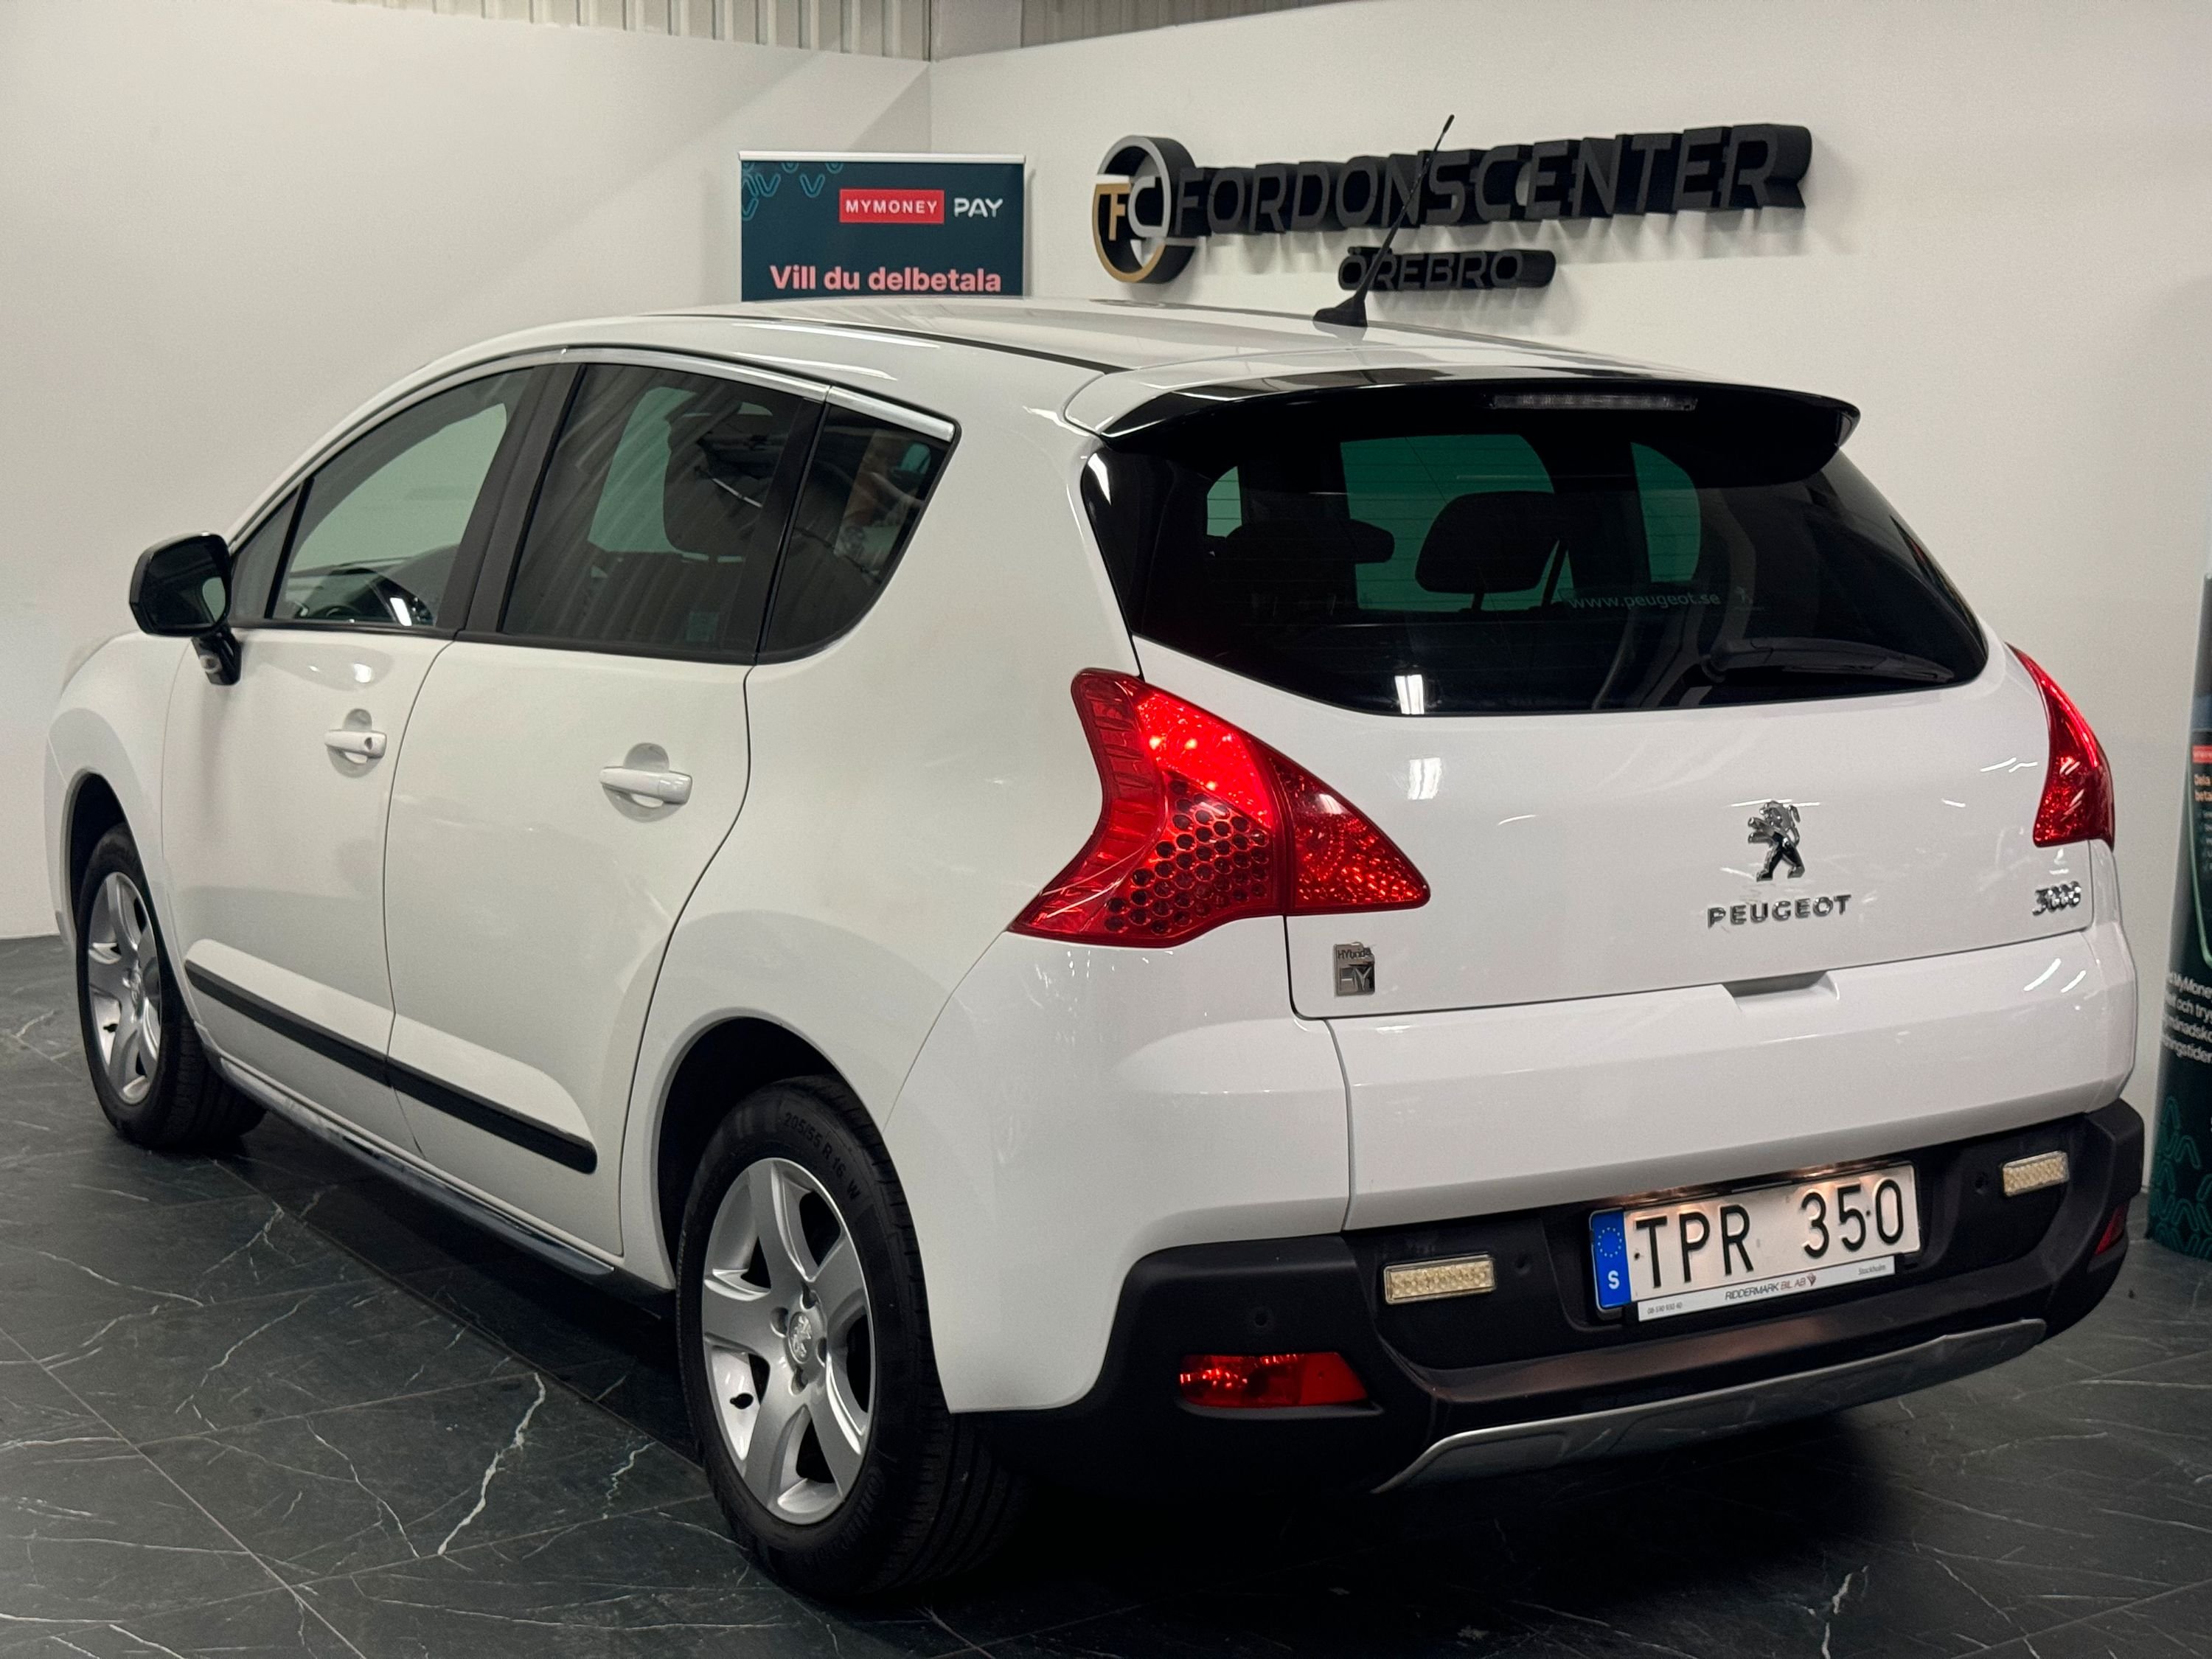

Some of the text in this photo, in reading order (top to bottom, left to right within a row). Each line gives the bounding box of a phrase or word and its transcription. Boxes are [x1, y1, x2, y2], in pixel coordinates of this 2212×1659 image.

[1175, 124, 1784, 238] FORDONSCENTER
[844, 198, 1004, 218] MYMONEY PAY
[770, 264, 1001, 292] Vill du delbetala
[1568, 591, 1722, 610] www.peugeot.se
[1707, 894, 1852, 929] PEUGEOT
[785, 1112, 862, 1200] 205/55 R 16 W
[1635, 1178, 1905, 1289] TPR 350
[1607, 1270, 1620, 1290] S
